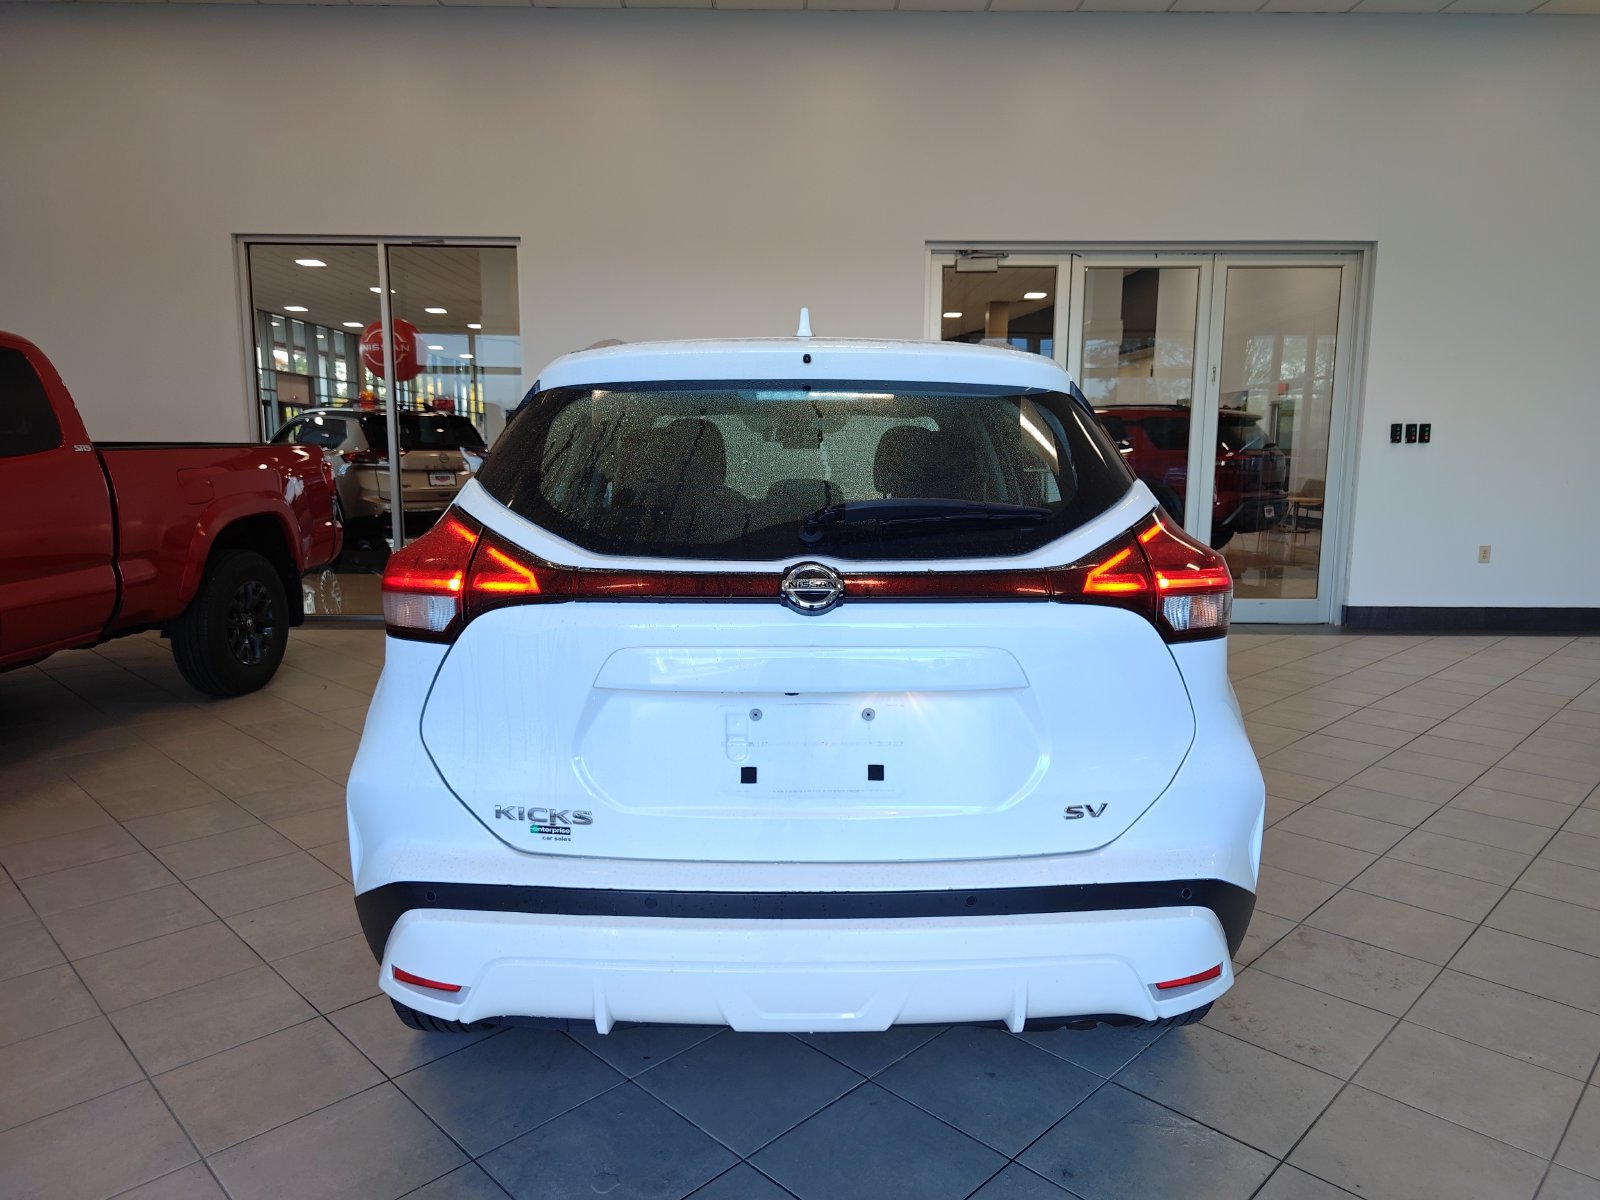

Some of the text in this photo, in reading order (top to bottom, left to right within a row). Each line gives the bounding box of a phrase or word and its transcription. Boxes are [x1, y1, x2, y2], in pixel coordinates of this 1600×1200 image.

[361, 343, 410, 352] NISAN
[788, 580, 837, 589] NISSAN
[495, 804, 593, 826] KICKS
[1064, 803, 1108, 820] SV
[531, 825, 571, 835] enterprise
